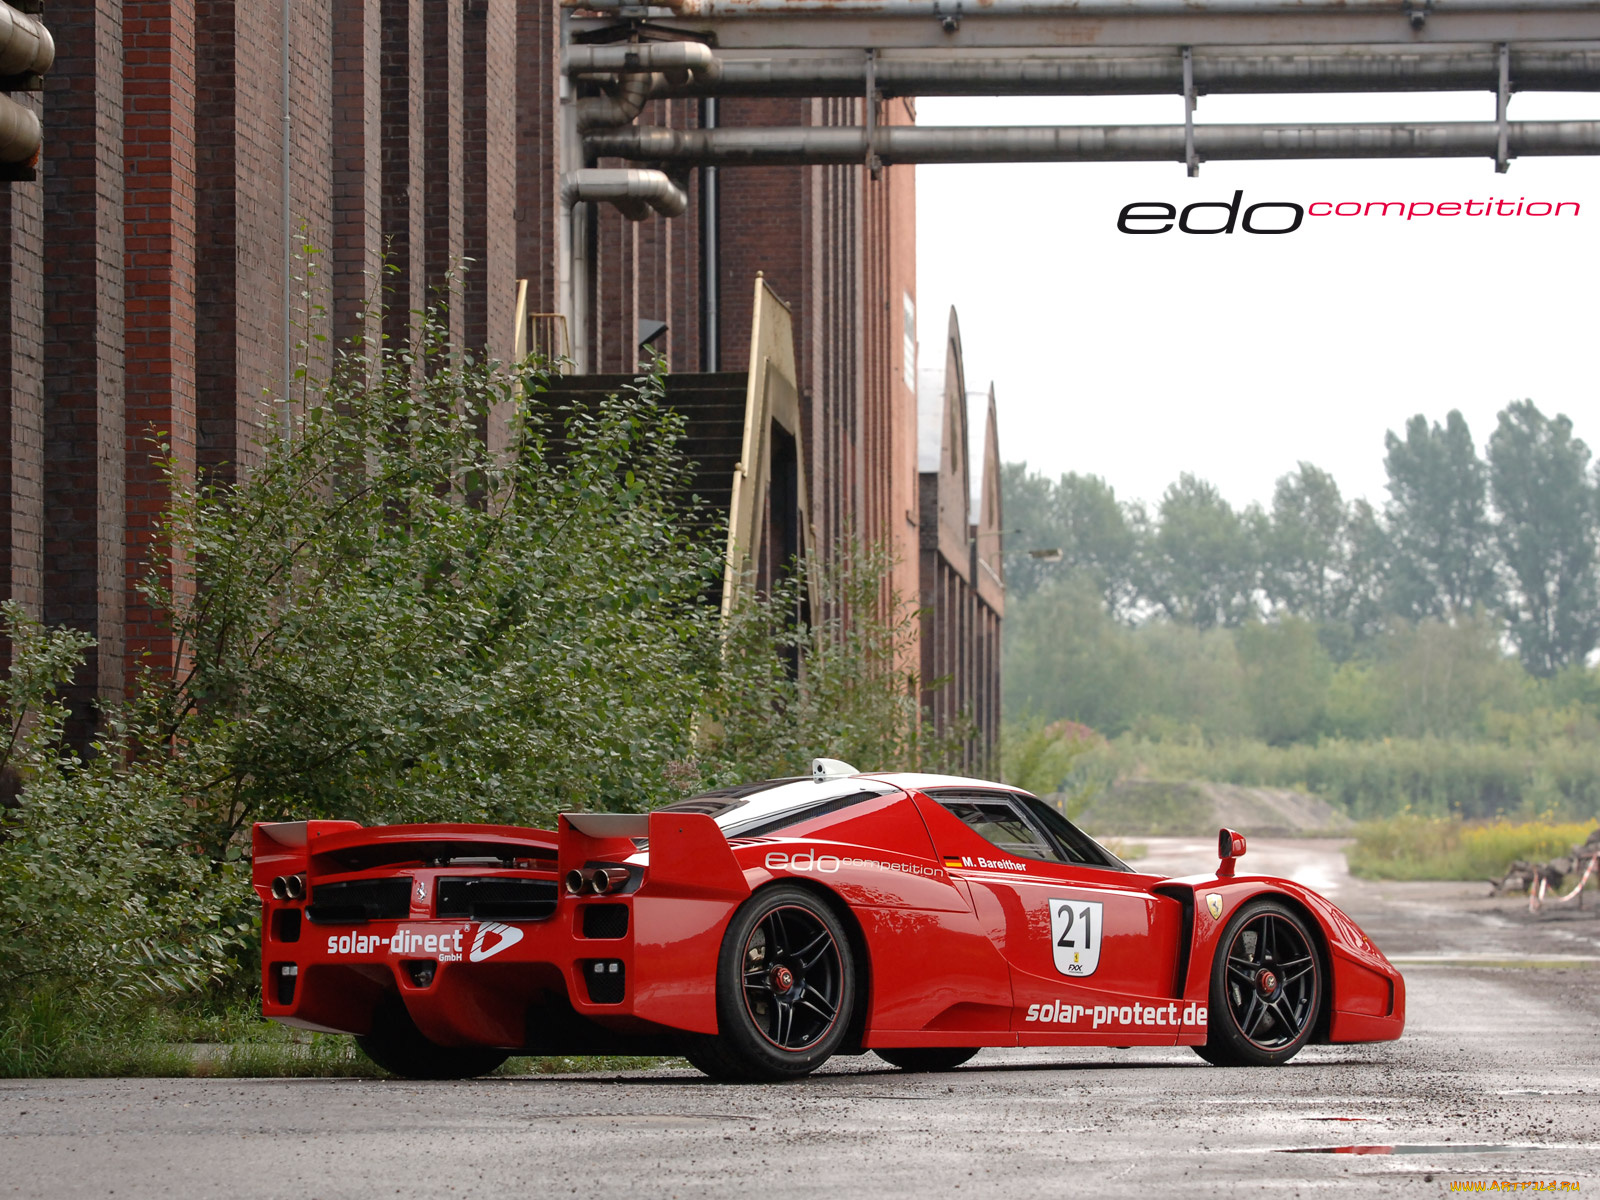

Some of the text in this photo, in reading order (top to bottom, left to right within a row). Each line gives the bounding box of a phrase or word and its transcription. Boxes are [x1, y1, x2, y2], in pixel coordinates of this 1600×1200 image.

[764, 848, 945, 878] edo competition
[961, 856, 1027, 872] M. Bareither
[1056, 904, 1092, 950] 21
[438, 953, 463, 962] GmbH
[1067, 963, 1083, 972] FXX
[1025, 999, 1208, 1029] solar-protect.de
